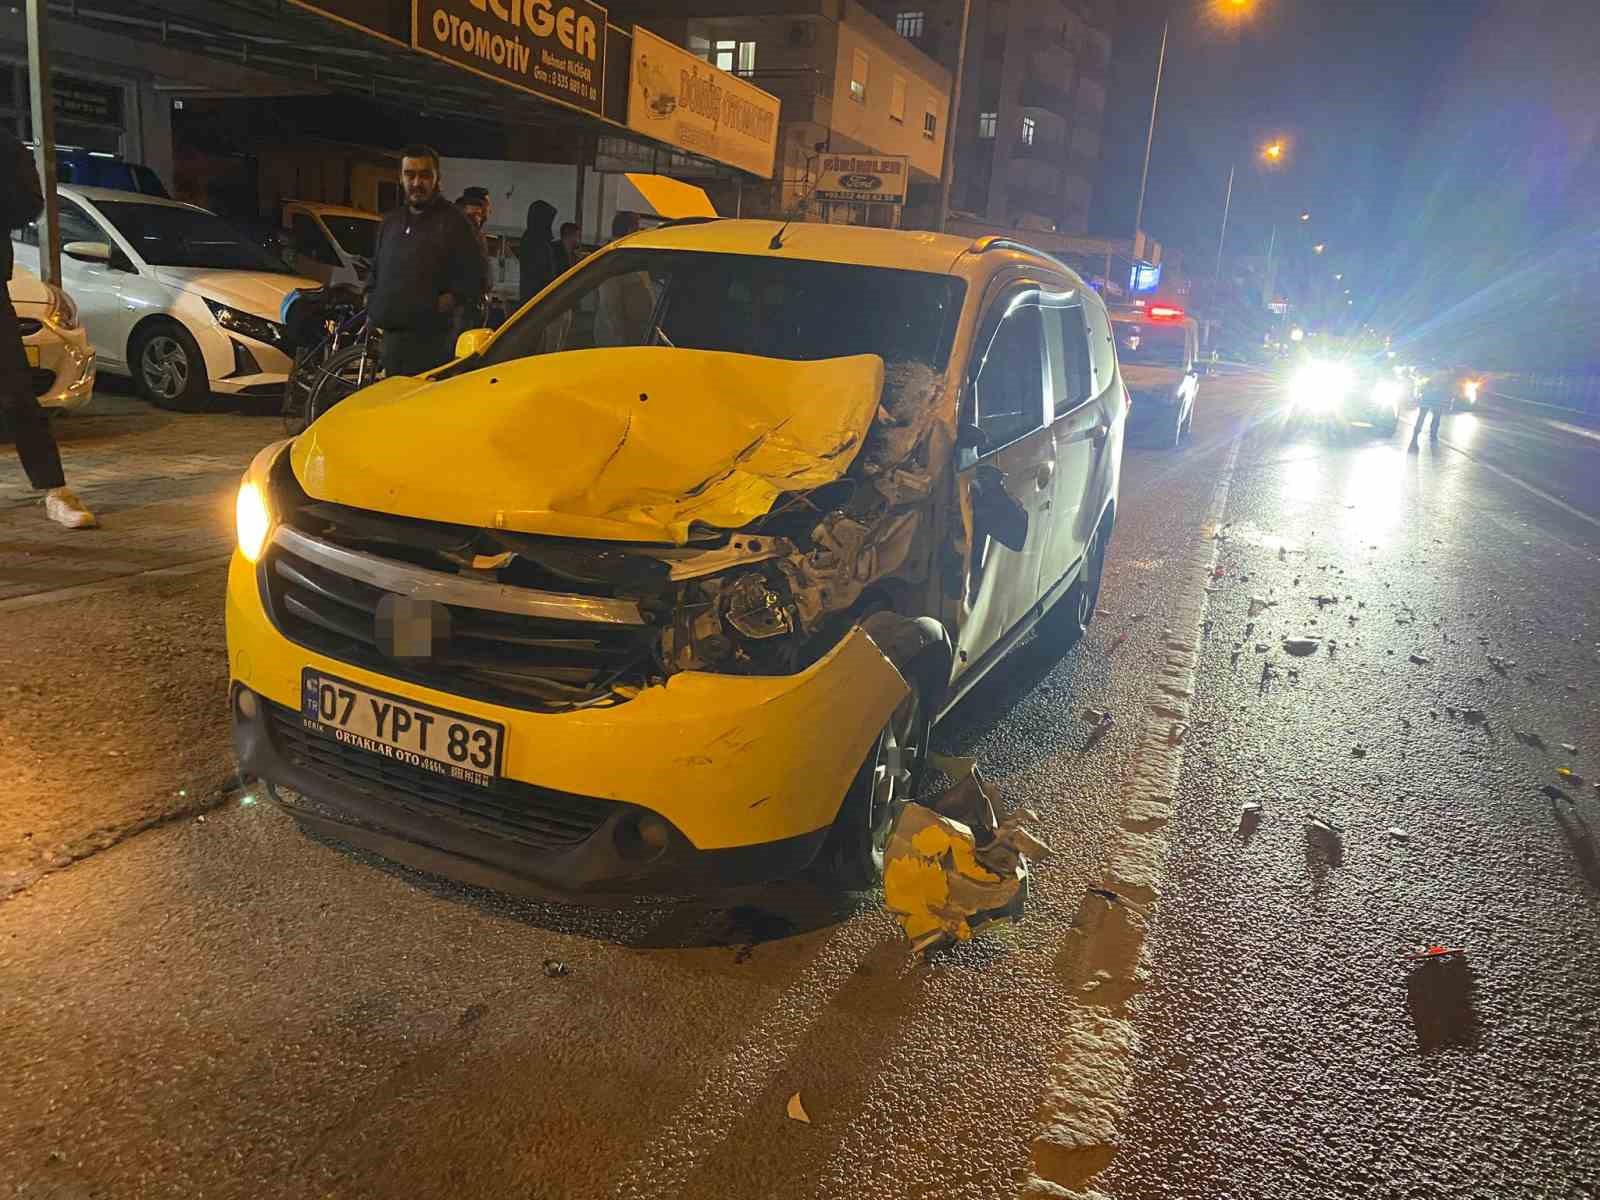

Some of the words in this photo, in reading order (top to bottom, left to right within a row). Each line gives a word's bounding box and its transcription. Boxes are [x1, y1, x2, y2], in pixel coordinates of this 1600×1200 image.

[433, 9, 530, 74] OTOMOTİV
[307, 698, 318, 712] TR
[320, 684, 357, 726] 07
[370, 698, 434, 751] YPT
[447, 723, 493, 769] 83
[335, 729, 393, 759] ORTAKLAR
[395, 750, 420, 766] OTO
